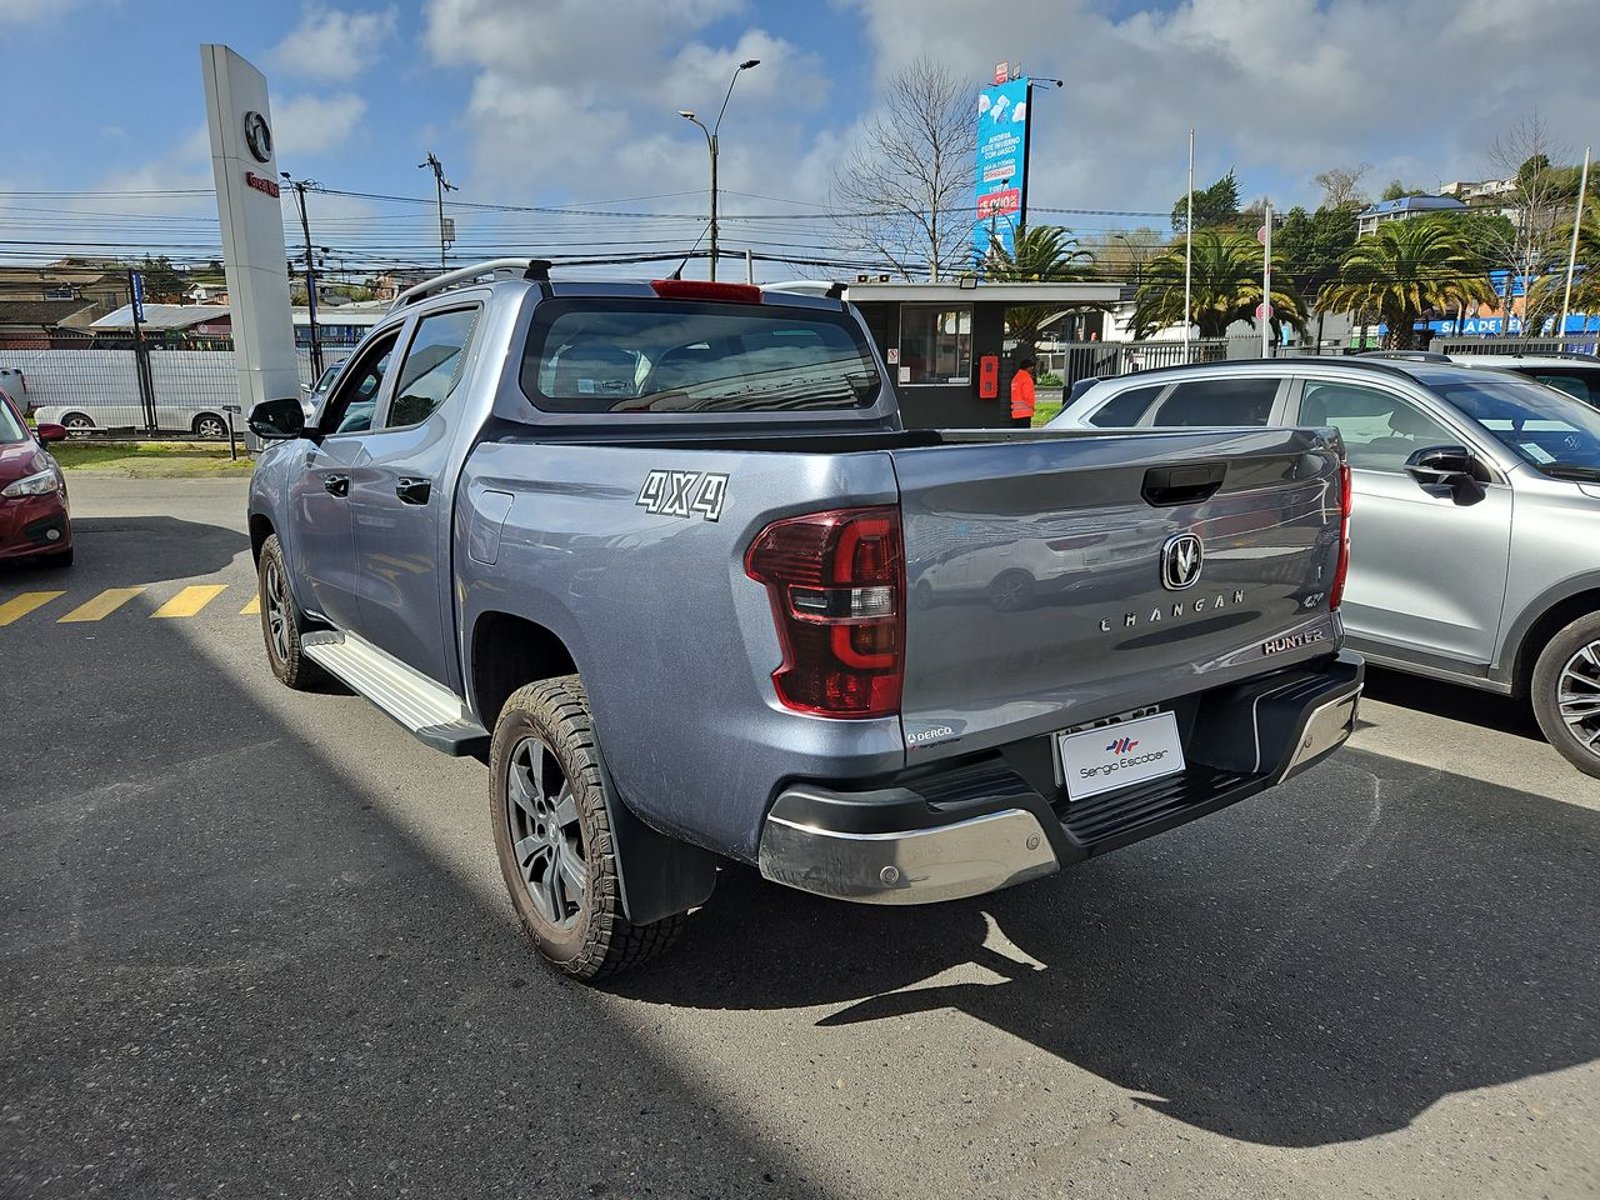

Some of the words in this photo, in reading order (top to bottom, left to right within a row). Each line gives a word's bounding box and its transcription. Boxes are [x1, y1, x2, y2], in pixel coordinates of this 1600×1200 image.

[1479, 320, 1496, 331] DE
[635, 469, 730, 523] 4X4
[1100, 590, 1244, 632] CHANGAN
[1263, 629, 1325, 656] HUNTER
[917, 726, 952, 742] DERCO
[1120, 749, 1168, 768] Escobar
